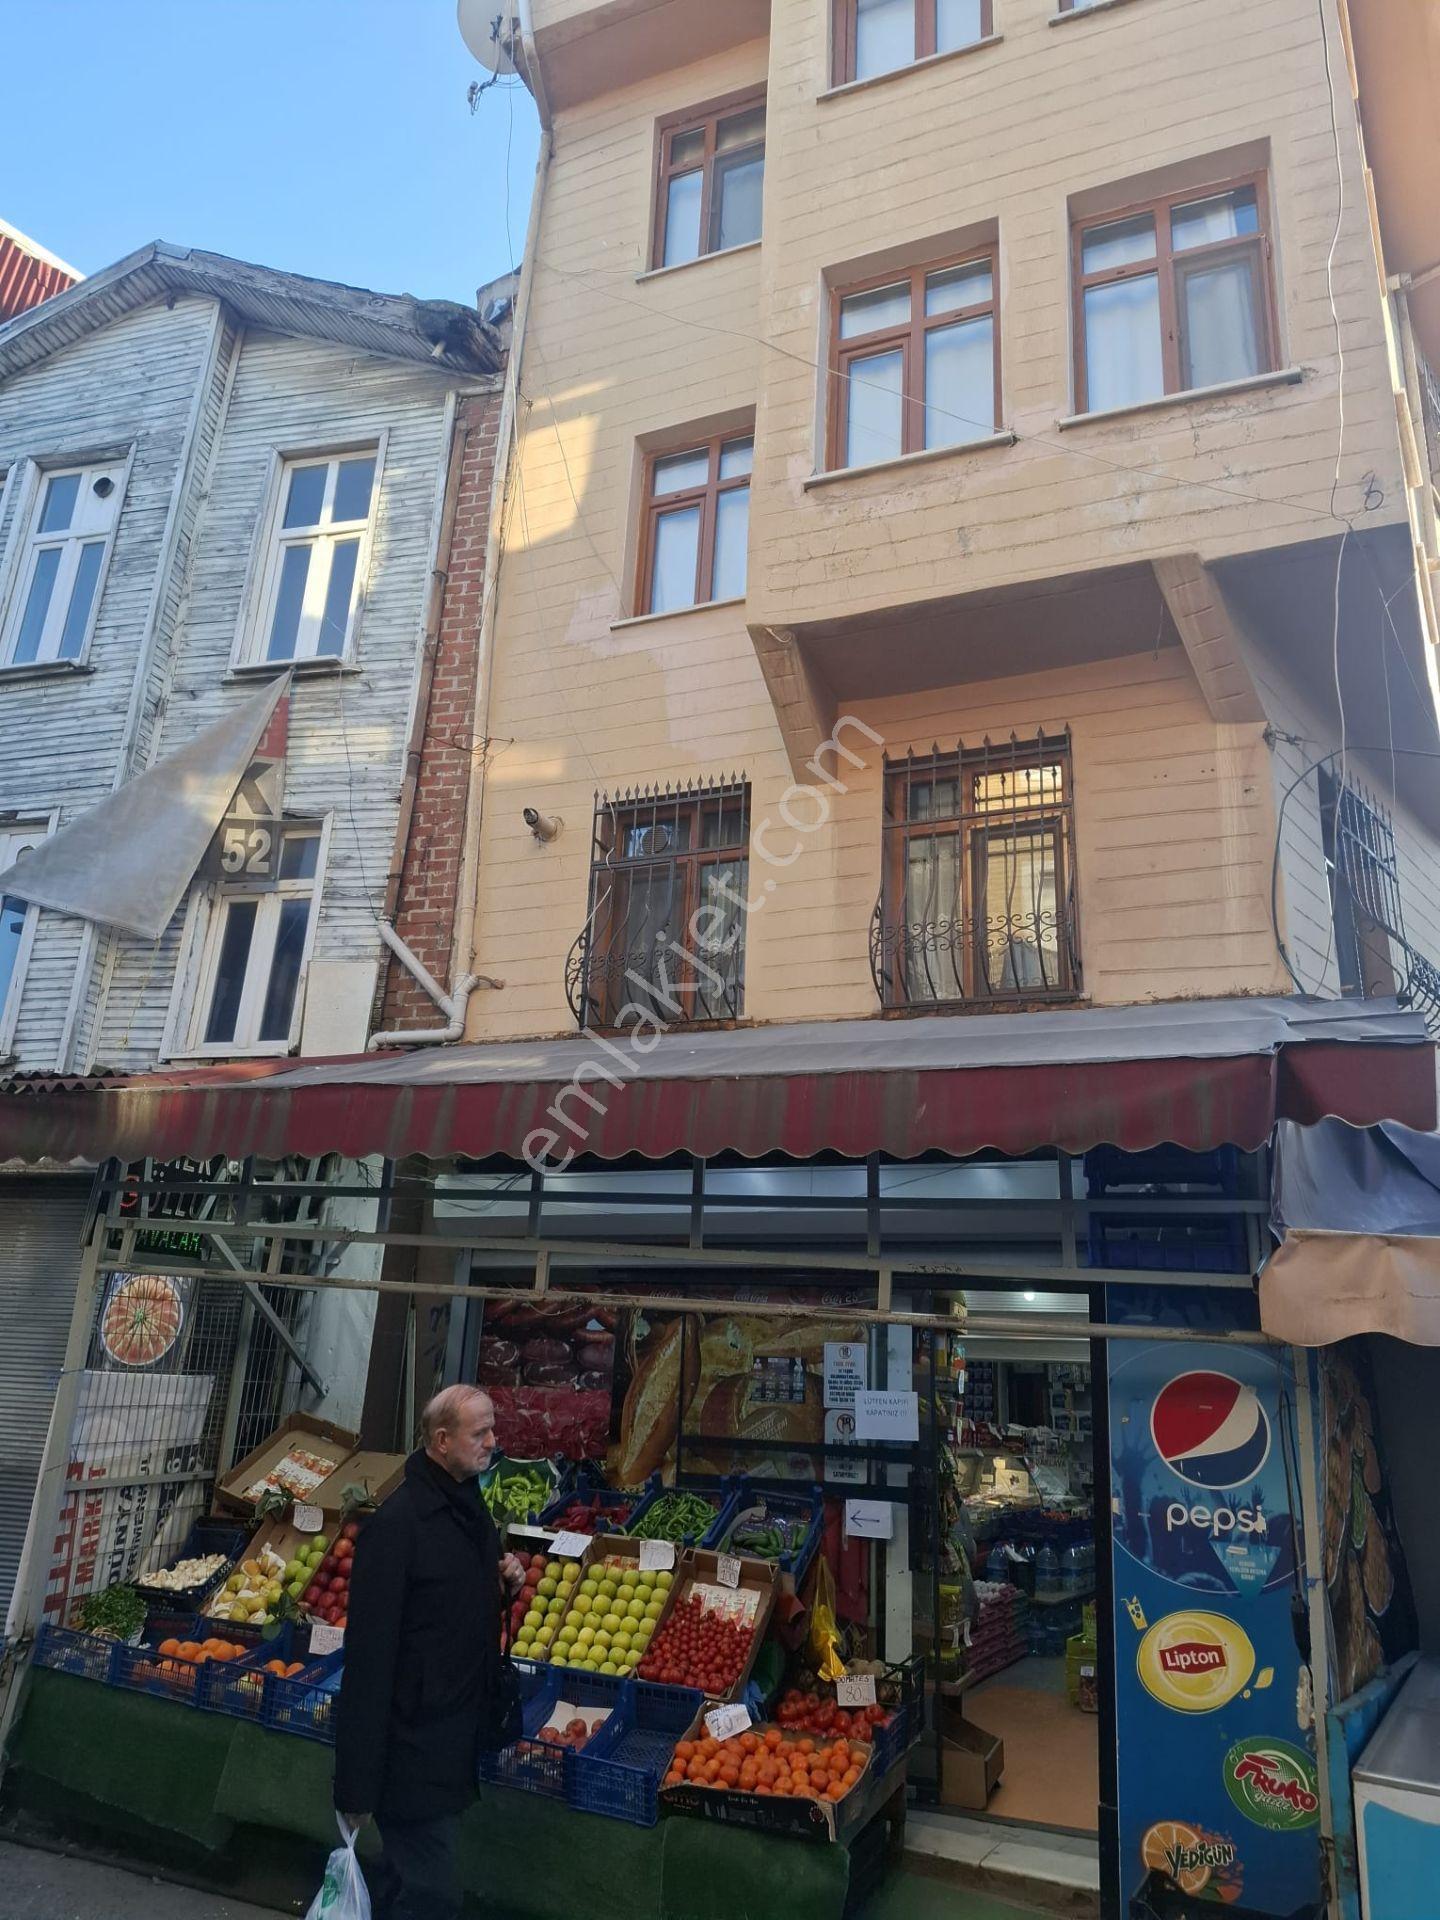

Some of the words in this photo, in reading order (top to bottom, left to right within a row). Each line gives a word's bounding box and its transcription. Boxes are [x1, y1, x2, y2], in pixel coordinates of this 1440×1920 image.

[1167, 1503, 1267, 1536] pepsi
[1164, 1650, 1220, 1670] Lipton
[1164, 1842, 1234, 1878] YEDİGÜN
